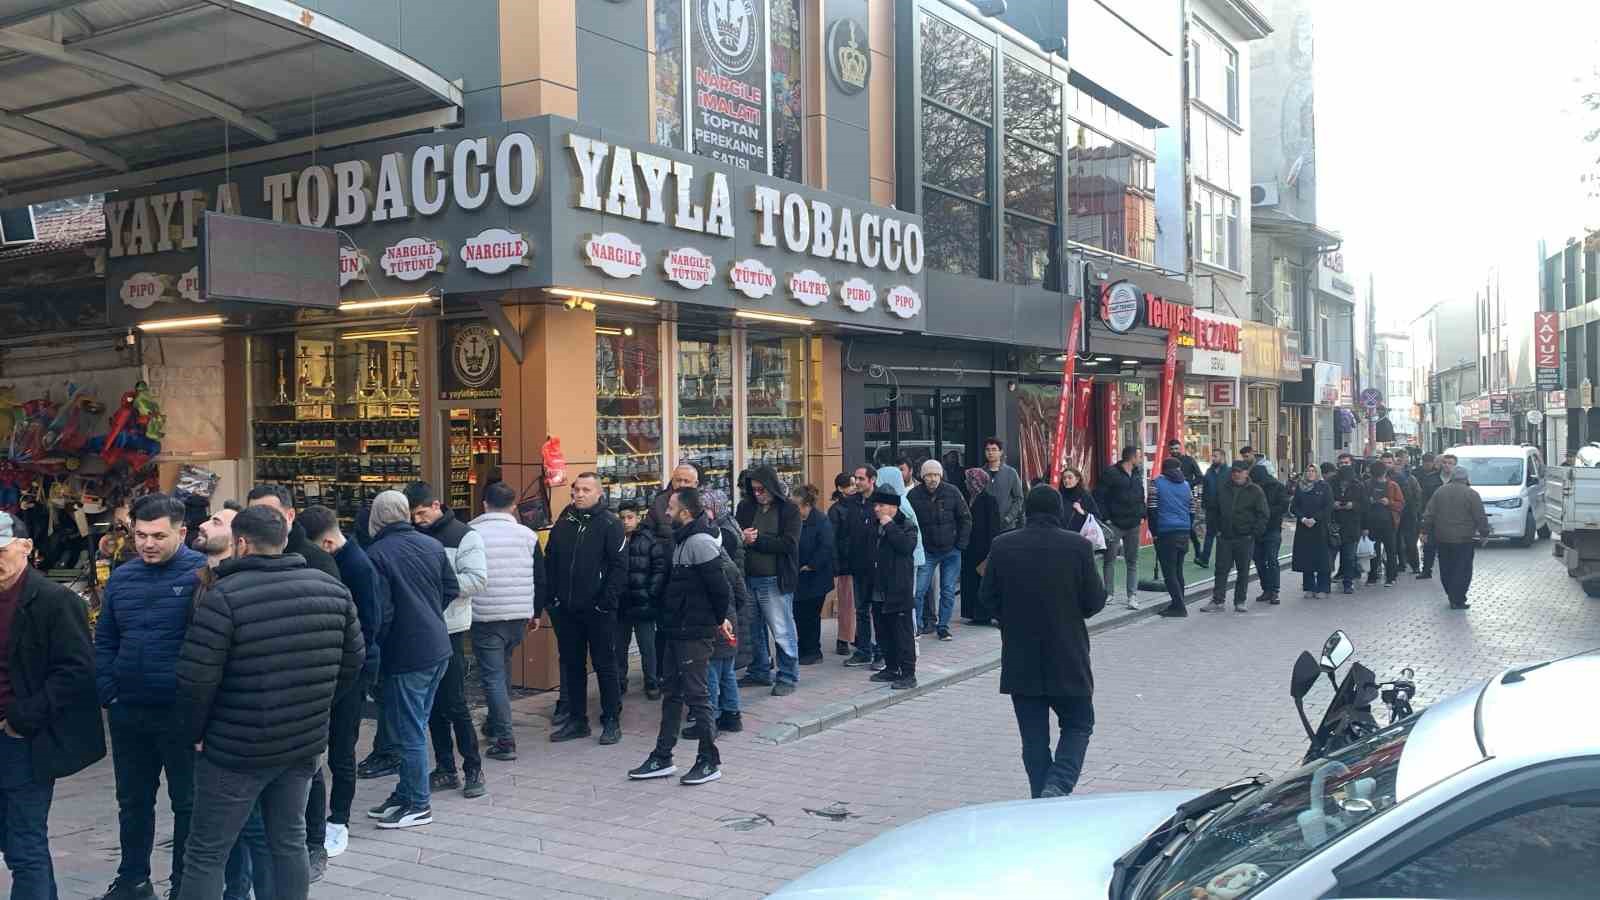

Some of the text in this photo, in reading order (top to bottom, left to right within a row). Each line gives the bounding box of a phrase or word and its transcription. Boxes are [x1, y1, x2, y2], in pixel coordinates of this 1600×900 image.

[702, 112, 758, 139] TOPTAN
[695, 128, 764, 158] PEREKANDE
[263, 132, 539, 229] TOBACCO
[568, 133, 924, 275] YAYLA TOBACCO
[390, 257, 434, 273] TÜTÜNÜ
[671, 267, 710, 282] TÜTÜNÜ
[734, 267, 773, 287] TÜTÜN
[846, 287, 871, 303] PURO
[1539, 314, 1555, 364] YAVUZ
[1214, 384, 1231, 402] E
